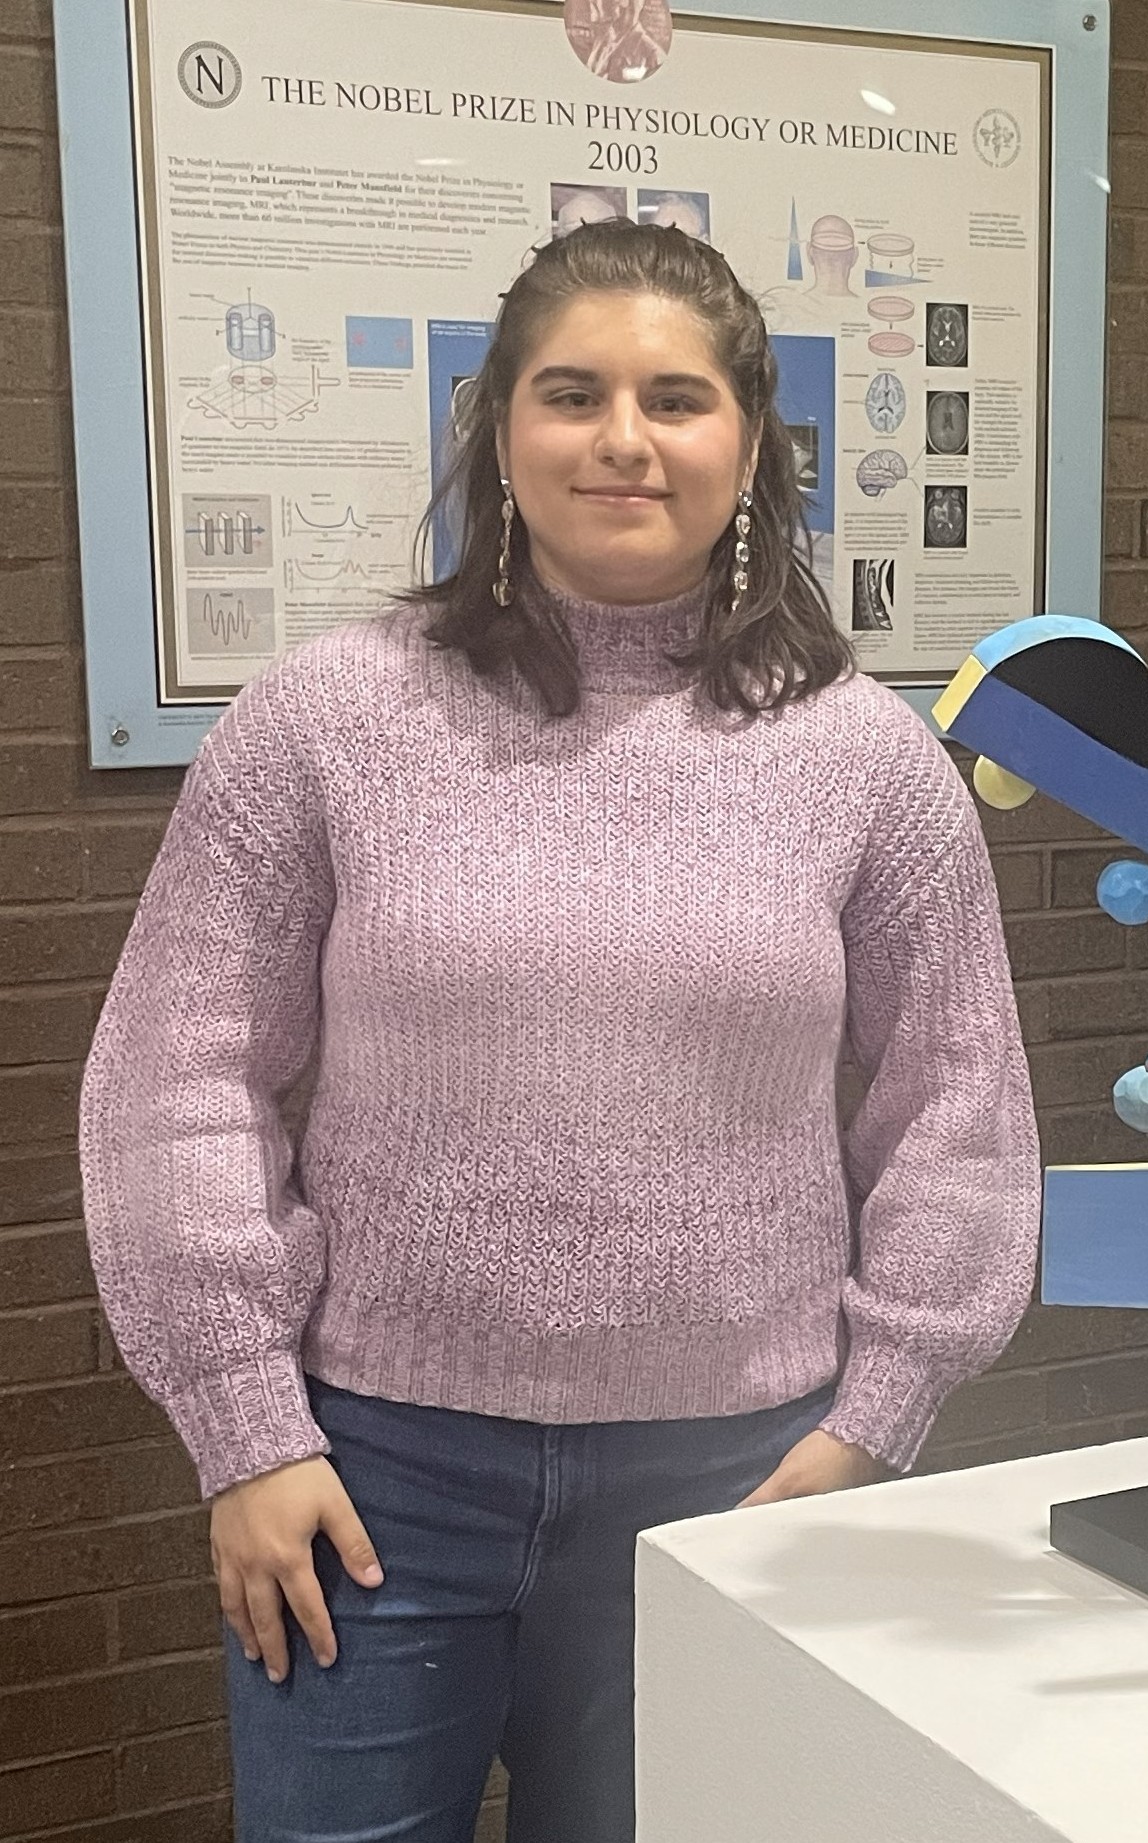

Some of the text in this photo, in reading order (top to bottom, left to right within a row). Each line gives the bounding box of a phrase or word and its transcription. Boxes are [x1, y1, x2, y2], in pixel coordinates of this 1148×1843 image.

[195, 54, 224, 96] N
[261, 76, 326, 106] THE
[335, 83, 442, 117] NOBEL
[452, 92, 537, 125] PRIZE
[546, 101, 575, 127] IN
[585, 103, 771, 143] PHYSIOLOGY
[779, 120, 817, 147] OR
[826, 124, 959, 157] MEDICINE
[588, 140, 659, 175] 2003
[251, 175, 269, 183] Paul
[273, 176, 316, 187] Lauterbur
[337, 181, 357, 189] Peter
[361, 182, 402, 192] Mansfield
